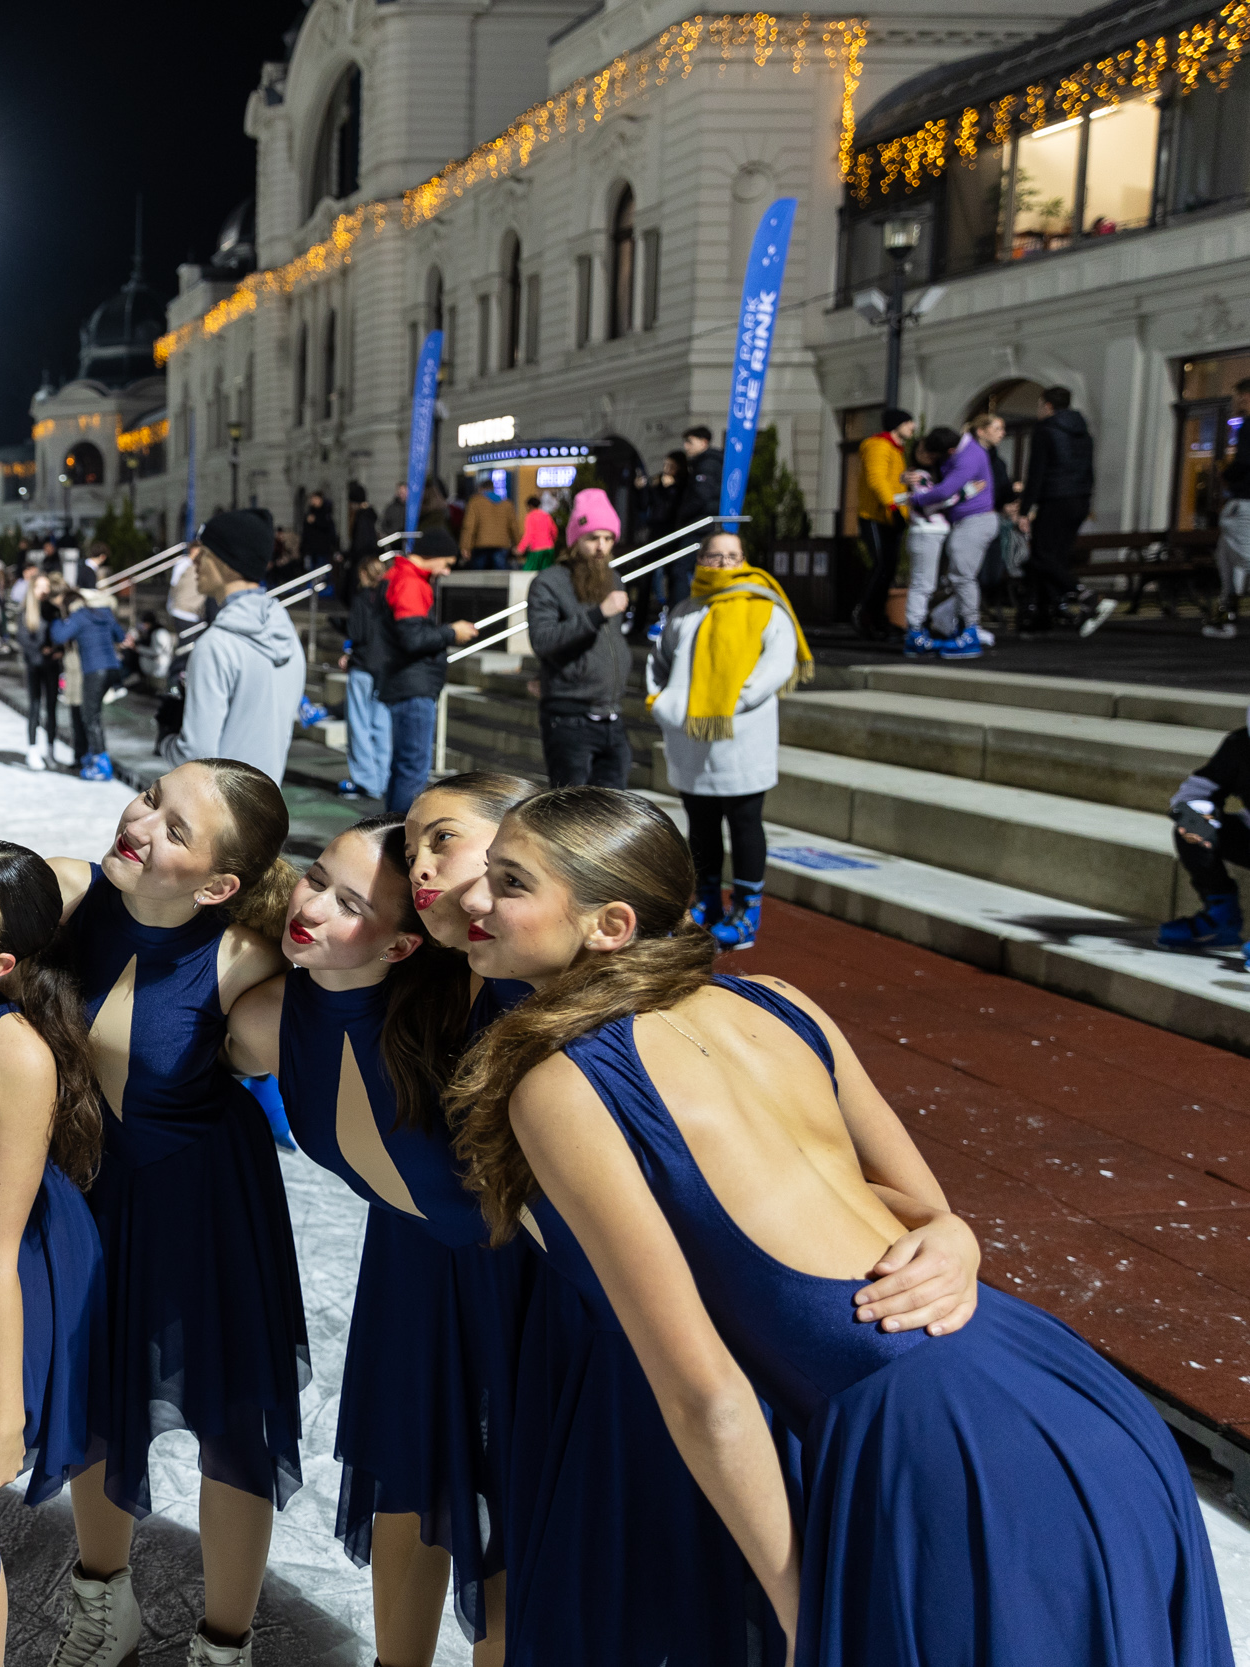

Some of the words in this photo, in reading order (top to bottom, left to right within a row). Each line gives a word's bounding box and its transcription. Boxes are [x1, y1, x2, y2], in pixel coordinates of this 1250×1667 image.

[739, 296, 760, 361] PARK
[750, 289, 777, 372] RINK
[733, 365, 750, 419] CITY
[743, 378, 761, 430] ICE
